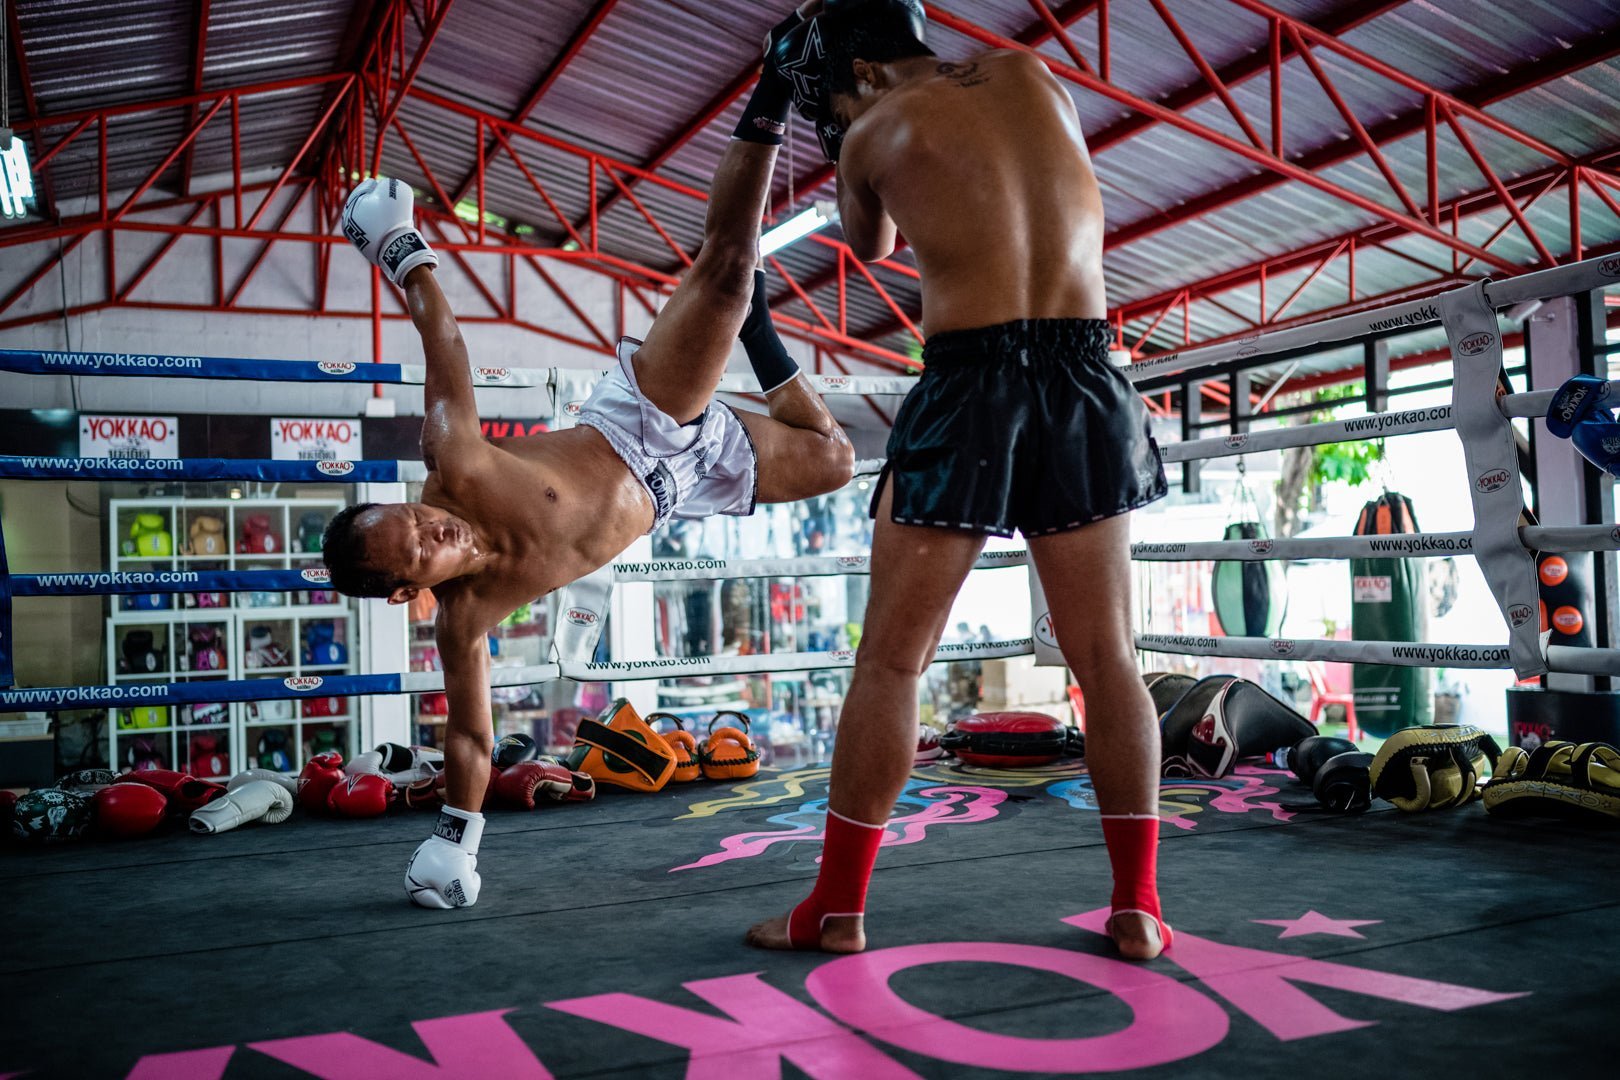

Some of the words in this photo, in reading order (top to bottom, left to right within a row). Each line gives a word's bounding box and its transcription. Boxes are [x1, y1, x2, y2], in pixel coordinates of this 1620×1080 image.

[42, 353, 202, 369] www.yokkao.com
[322, 361, 352, 370] YOKKAO
[87, 418, 168, 442] YOKKAO
[279, 420, 352, 443] YOKKAO
[22, 457, 184, 472] www.yokkao.com
[321, 462, 350, 471] YOKKAO
[37, 571, 199, 588] www.yokkao.com
[306, 568, 332, 577] YOKKA
[288, 676, 318, 686] YOKKAO
[2, 684, 169, 705] www.yokkao.com
